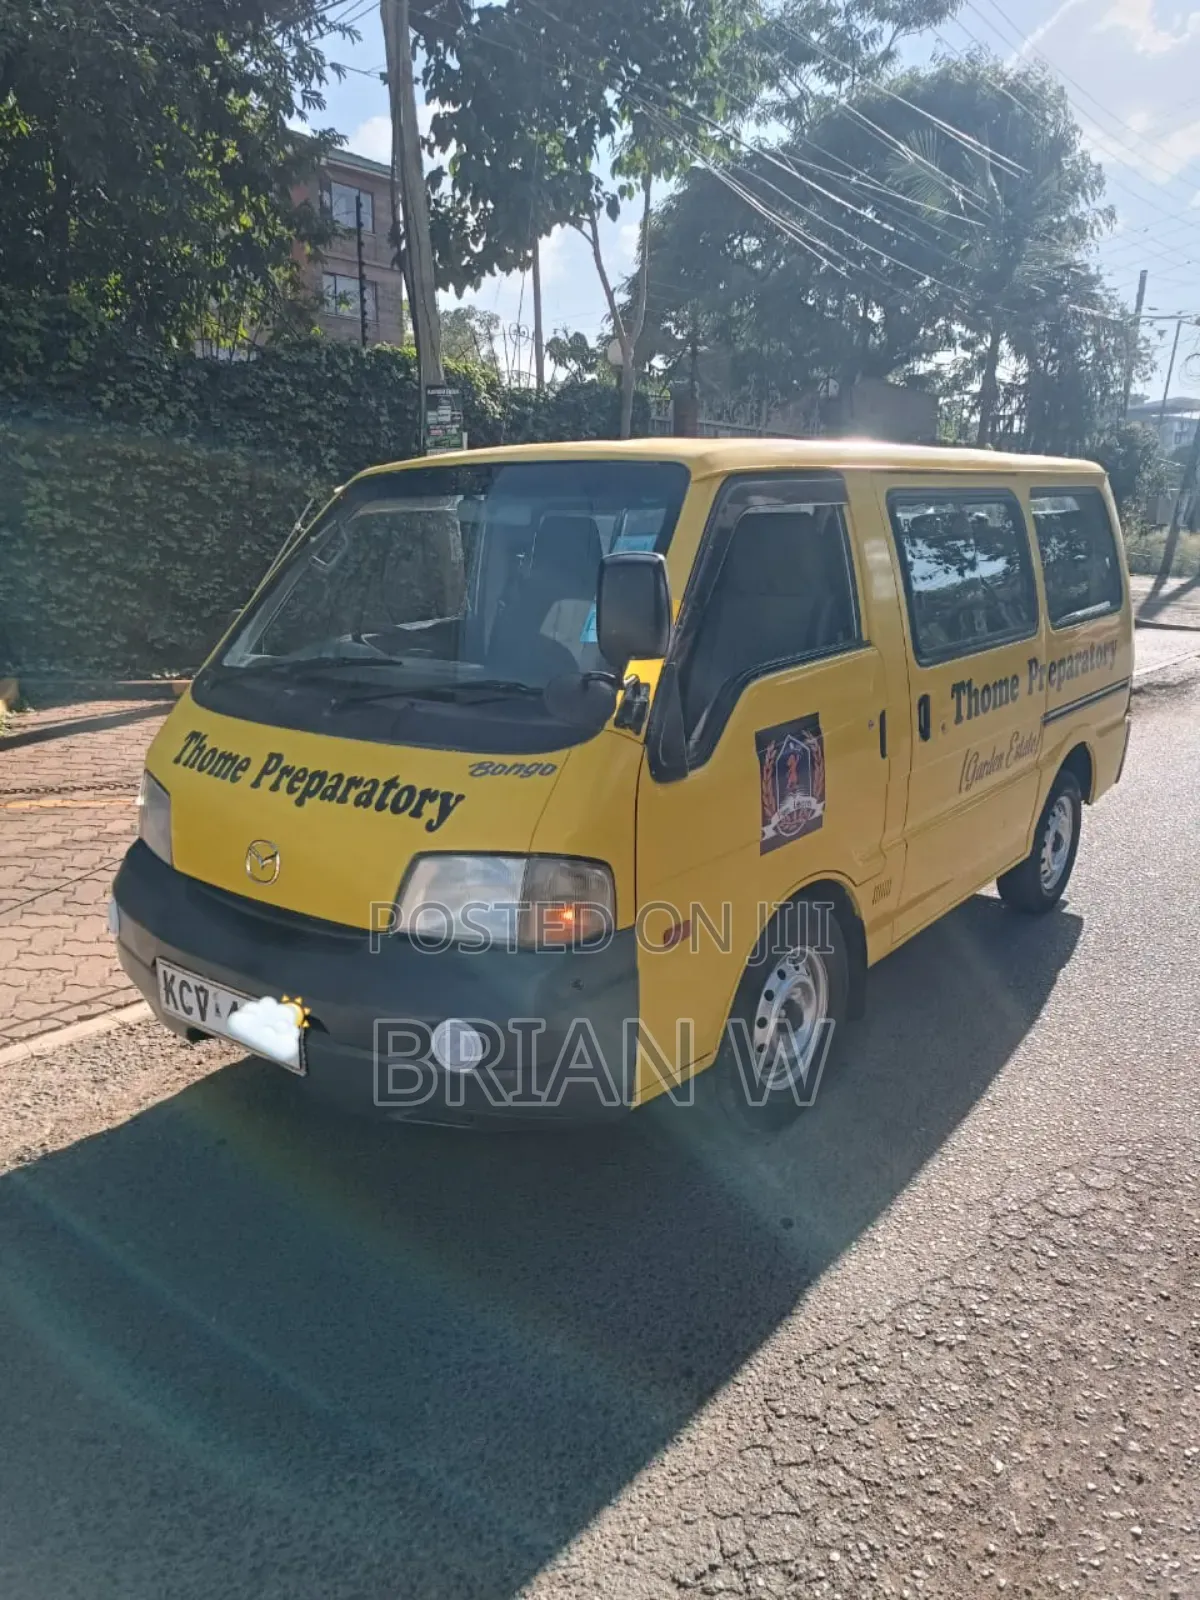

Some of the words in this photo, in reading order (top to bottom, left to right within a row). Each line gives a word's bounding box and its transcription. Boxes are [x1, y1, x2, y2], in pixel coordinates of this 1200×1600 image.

[951, 674, 1020, 725] Thome
[1027, 639, 1118, 695] Preparatory
[172, 730, 252, 784] Thome
[250, 752, 466, 833] Preparatory
[468, 760, 558, 779] Bongo
